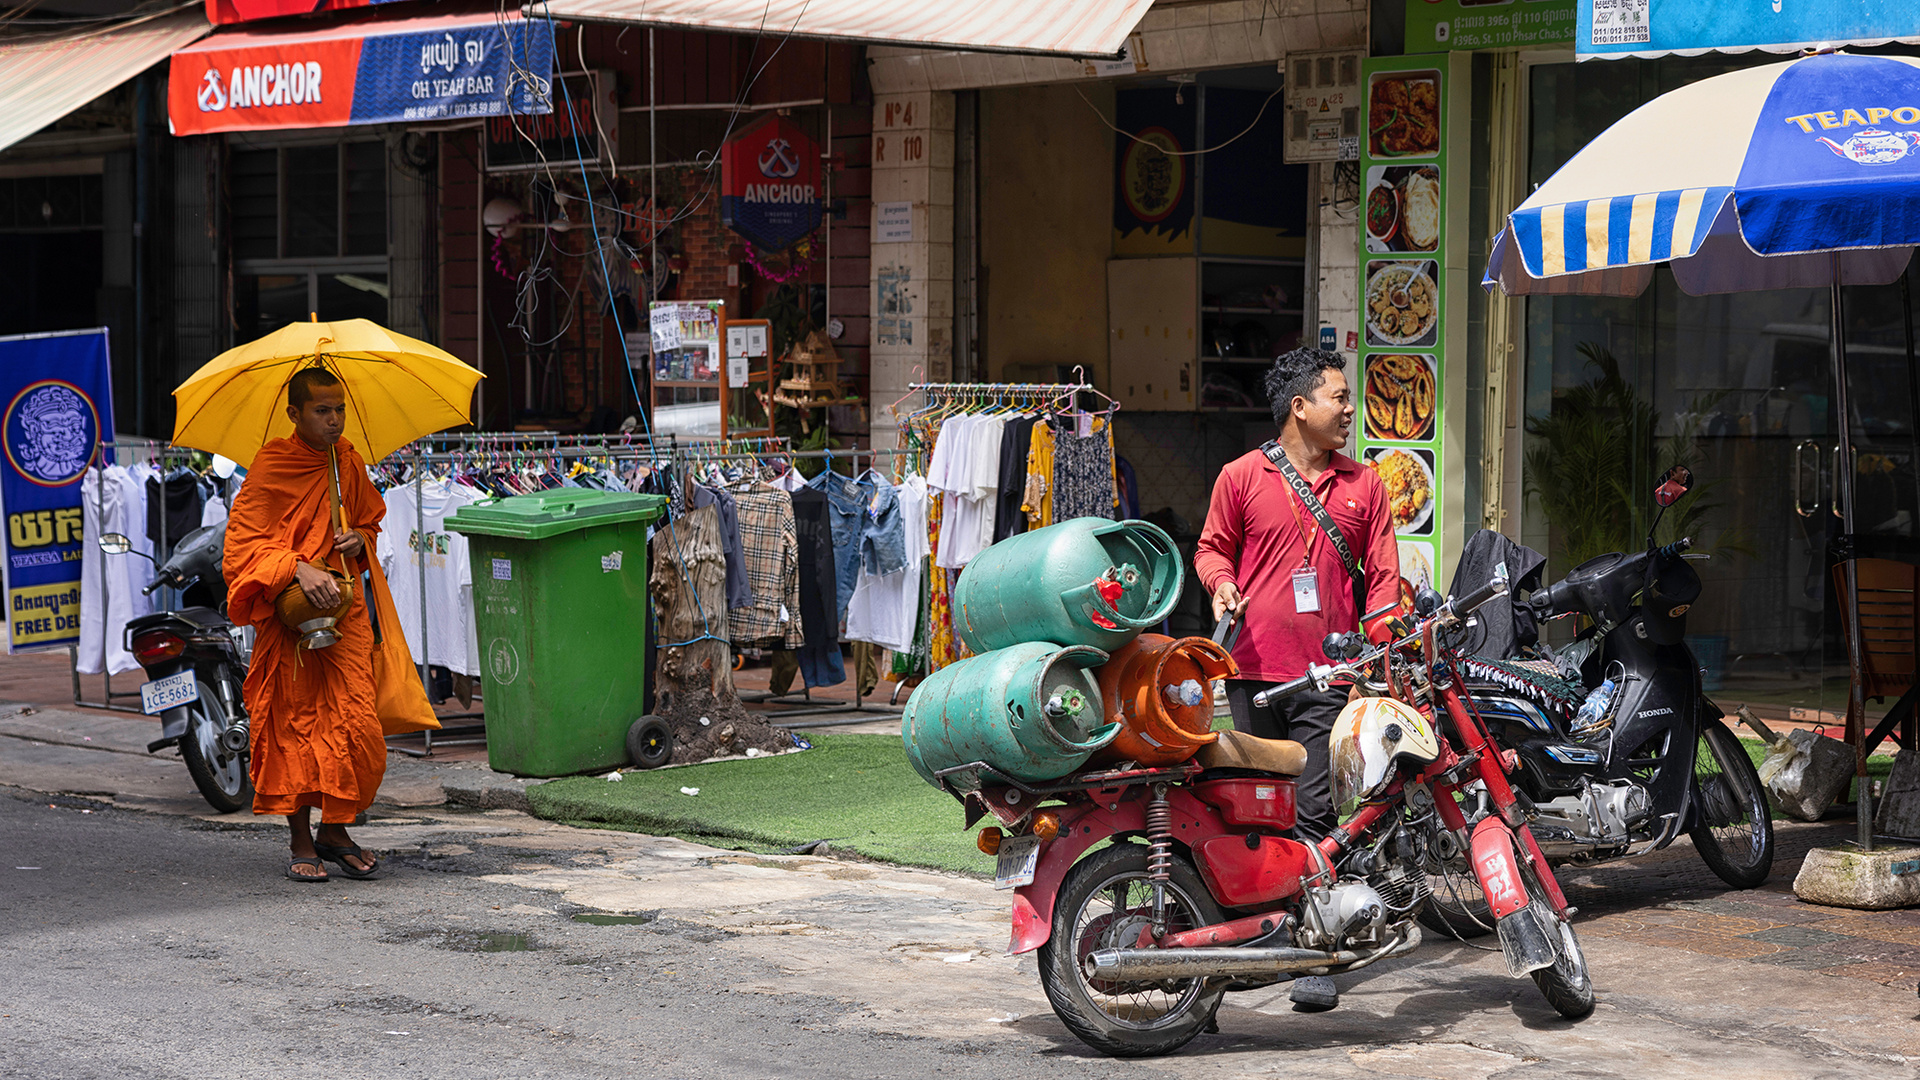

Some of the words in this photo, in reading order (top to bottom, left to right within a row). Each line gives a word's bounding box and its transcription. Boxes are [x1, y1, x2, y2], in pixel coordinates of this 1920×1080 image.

[1524, 12, 1541, 24] 110
[1482, 34, 1494, 44] St.
[1496, 32, 1512, 42] 110
[1513, 30, 1537, 42] Phsar
[1538, 28, 1562, 40] Chas,
[229, 61, 322, 109] ANCHOR
[412, 80, 430, 99] OH
[432, 78, 465, 98] YEAH
[467, 75, 494, 94] BAR
[559, 98, 592, 138] BAR
[1785, 106, 1920, 133] TEAPO
[876, 136, 886, 162] R
[744, 183, 815, 204] ANCHOR
[1280, 462, 1328, 522] LACOSTE
[1326, 526, 1358, 582] LACOSTE
[15, 618, 52, 636] FREE
[147, 683, 195, 709] 1CE-5682
[1638, 706, 1674, 719] HONDA
